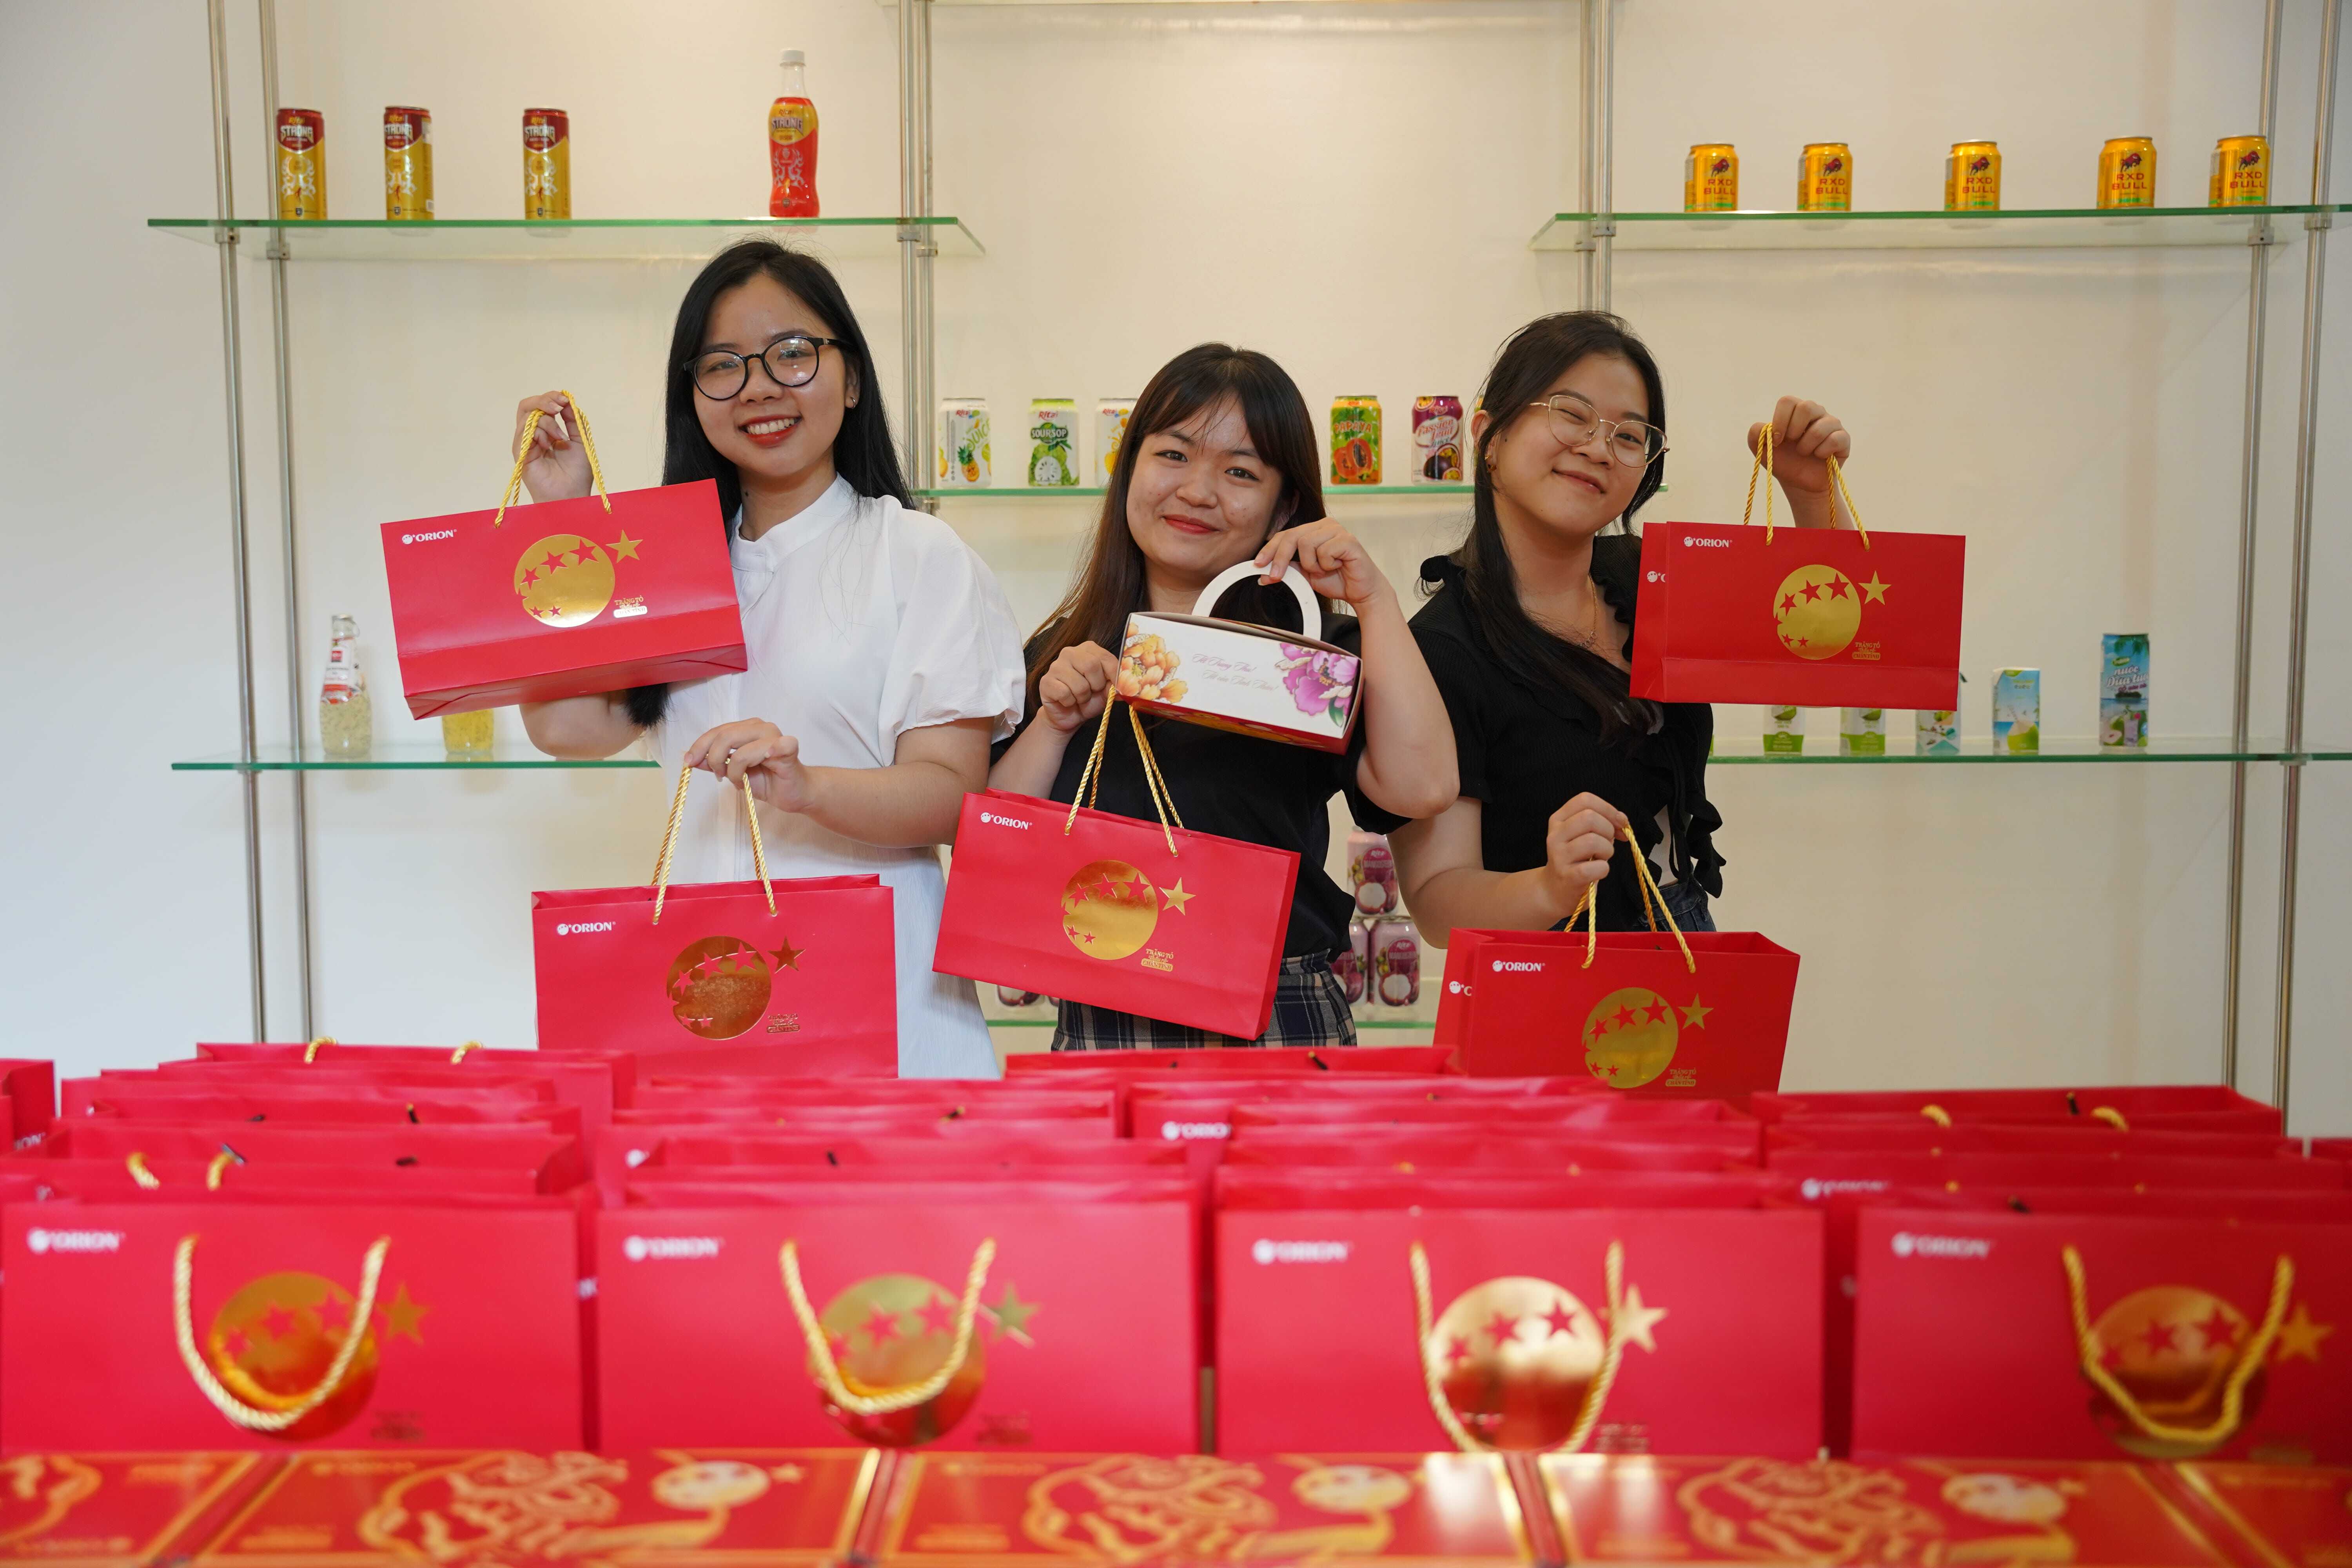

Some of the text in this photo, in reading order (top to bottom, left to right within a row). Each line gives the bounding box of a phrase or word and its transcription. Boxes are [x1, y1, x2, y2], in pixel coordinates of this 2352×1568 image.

[771, 118, 803, 134] STRONG
[280, 125, 314, 144] STRONG
[524, 125, 555, 144] STRONG
[2112, 182, 2147, 190] BULL
[1031, 428, 1067, 439] SOURSOP
[1334, 421, 1372, 434] PAPAYA
[1417, 419, 1453, 437] Passion
[416, 530, 454, 542] ORION
[1695, 538, 1729, 548] ORION
[993, 816, 1029, 830] ORION
[572, 922, 612, 933] ORION
[1505, 962, 1541, 971] ORION
[1182, 1122, 1232, 1139] ORIO
[53, 1230, 119, 1252] ORION
[650, 1237, 719, 1260] ORION
[1278, 1240, 1348, 1263] ORION
